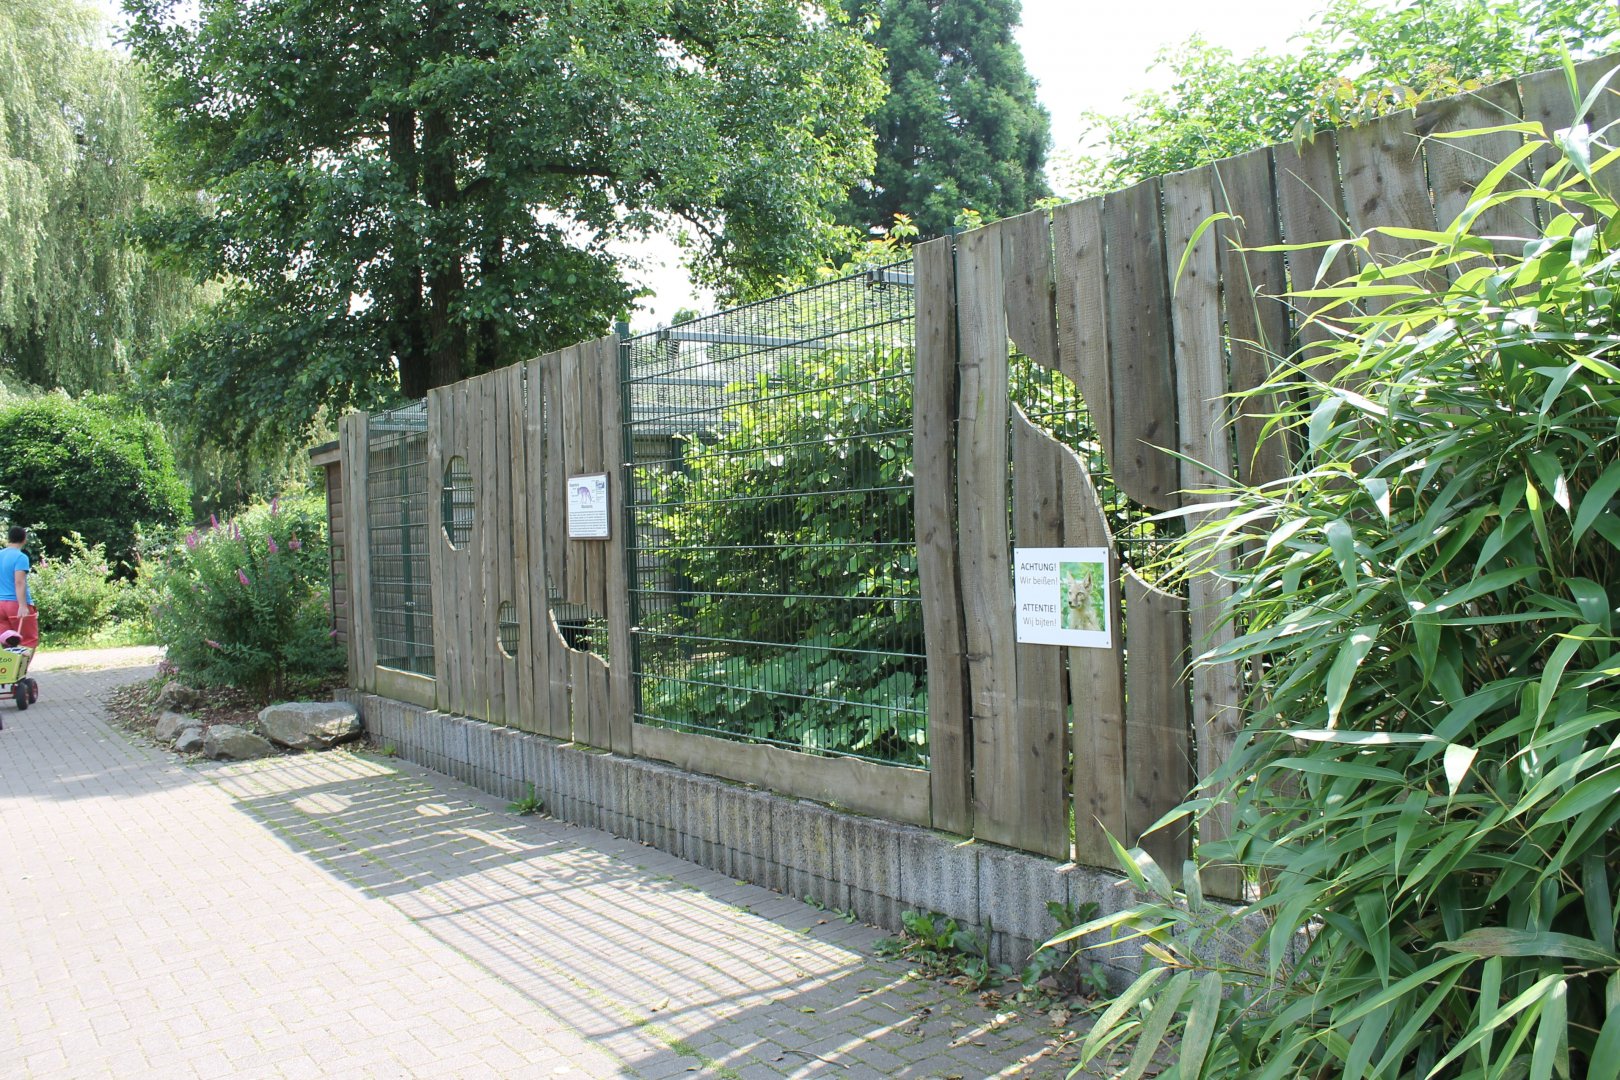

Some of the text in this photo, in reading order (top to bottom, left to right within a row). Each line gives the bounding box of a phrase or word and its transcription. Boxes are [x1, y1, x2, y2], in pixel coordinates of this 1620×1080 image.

[1021, 562, 1056, 571] ACHTUNG!
[1020, 576, 1057, 585] Wir beißen!
[1023, 604, 1056, 613] ATTENTIE!
[1023, 617, 1056, 628] Wij bijten!
